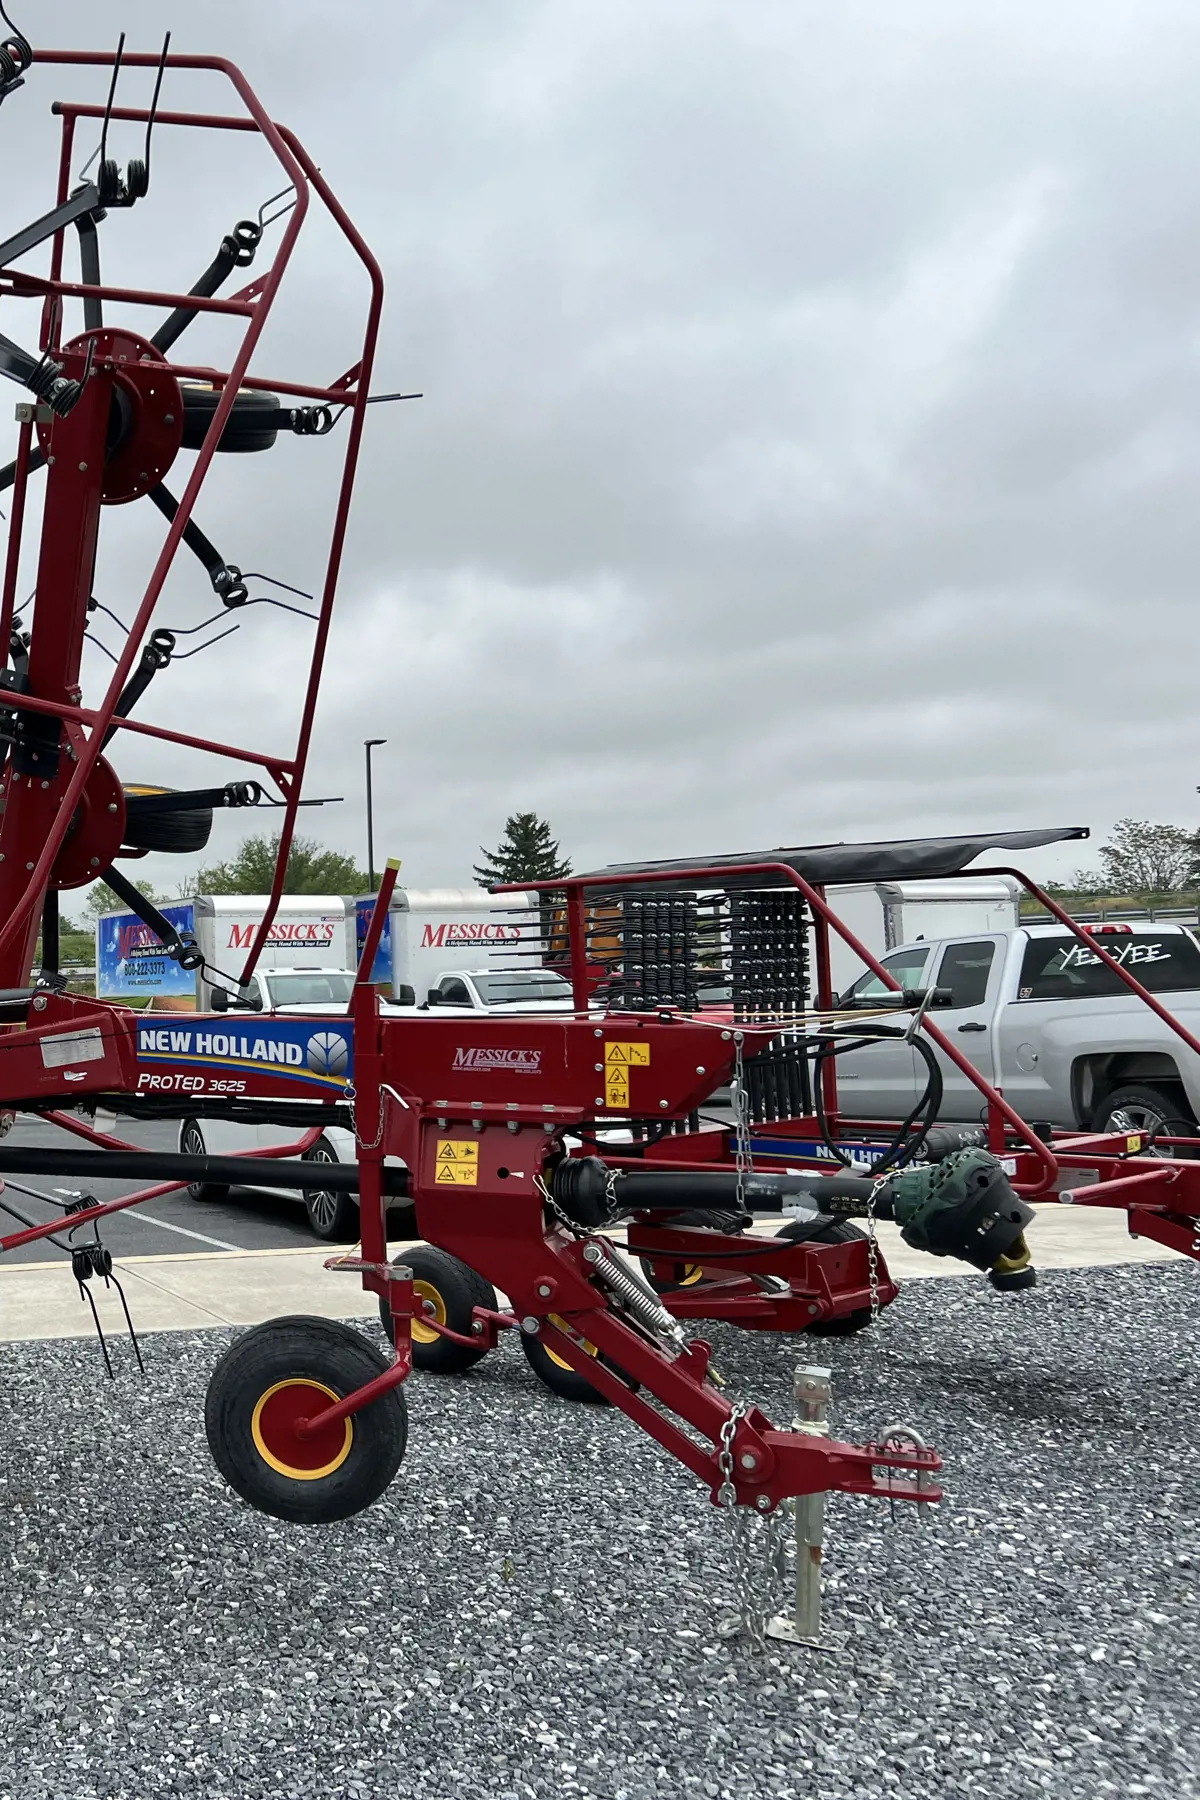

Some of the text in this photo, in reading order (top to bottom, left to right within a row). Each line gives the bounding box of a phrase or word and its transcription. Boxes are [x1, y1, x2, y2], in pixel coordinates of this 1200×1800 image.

[226, 924, 335, 949] MSSICK'S
[420, 923, 521, 948] MESSICKS
[124, 961, 166, 976] 800-222-3373
[139, 1030, 303, 1066] NEW HOLLAND
[452, 1047, 542, 1067] MESSICK'S
[208, 1079, 247, 1092] 3625
